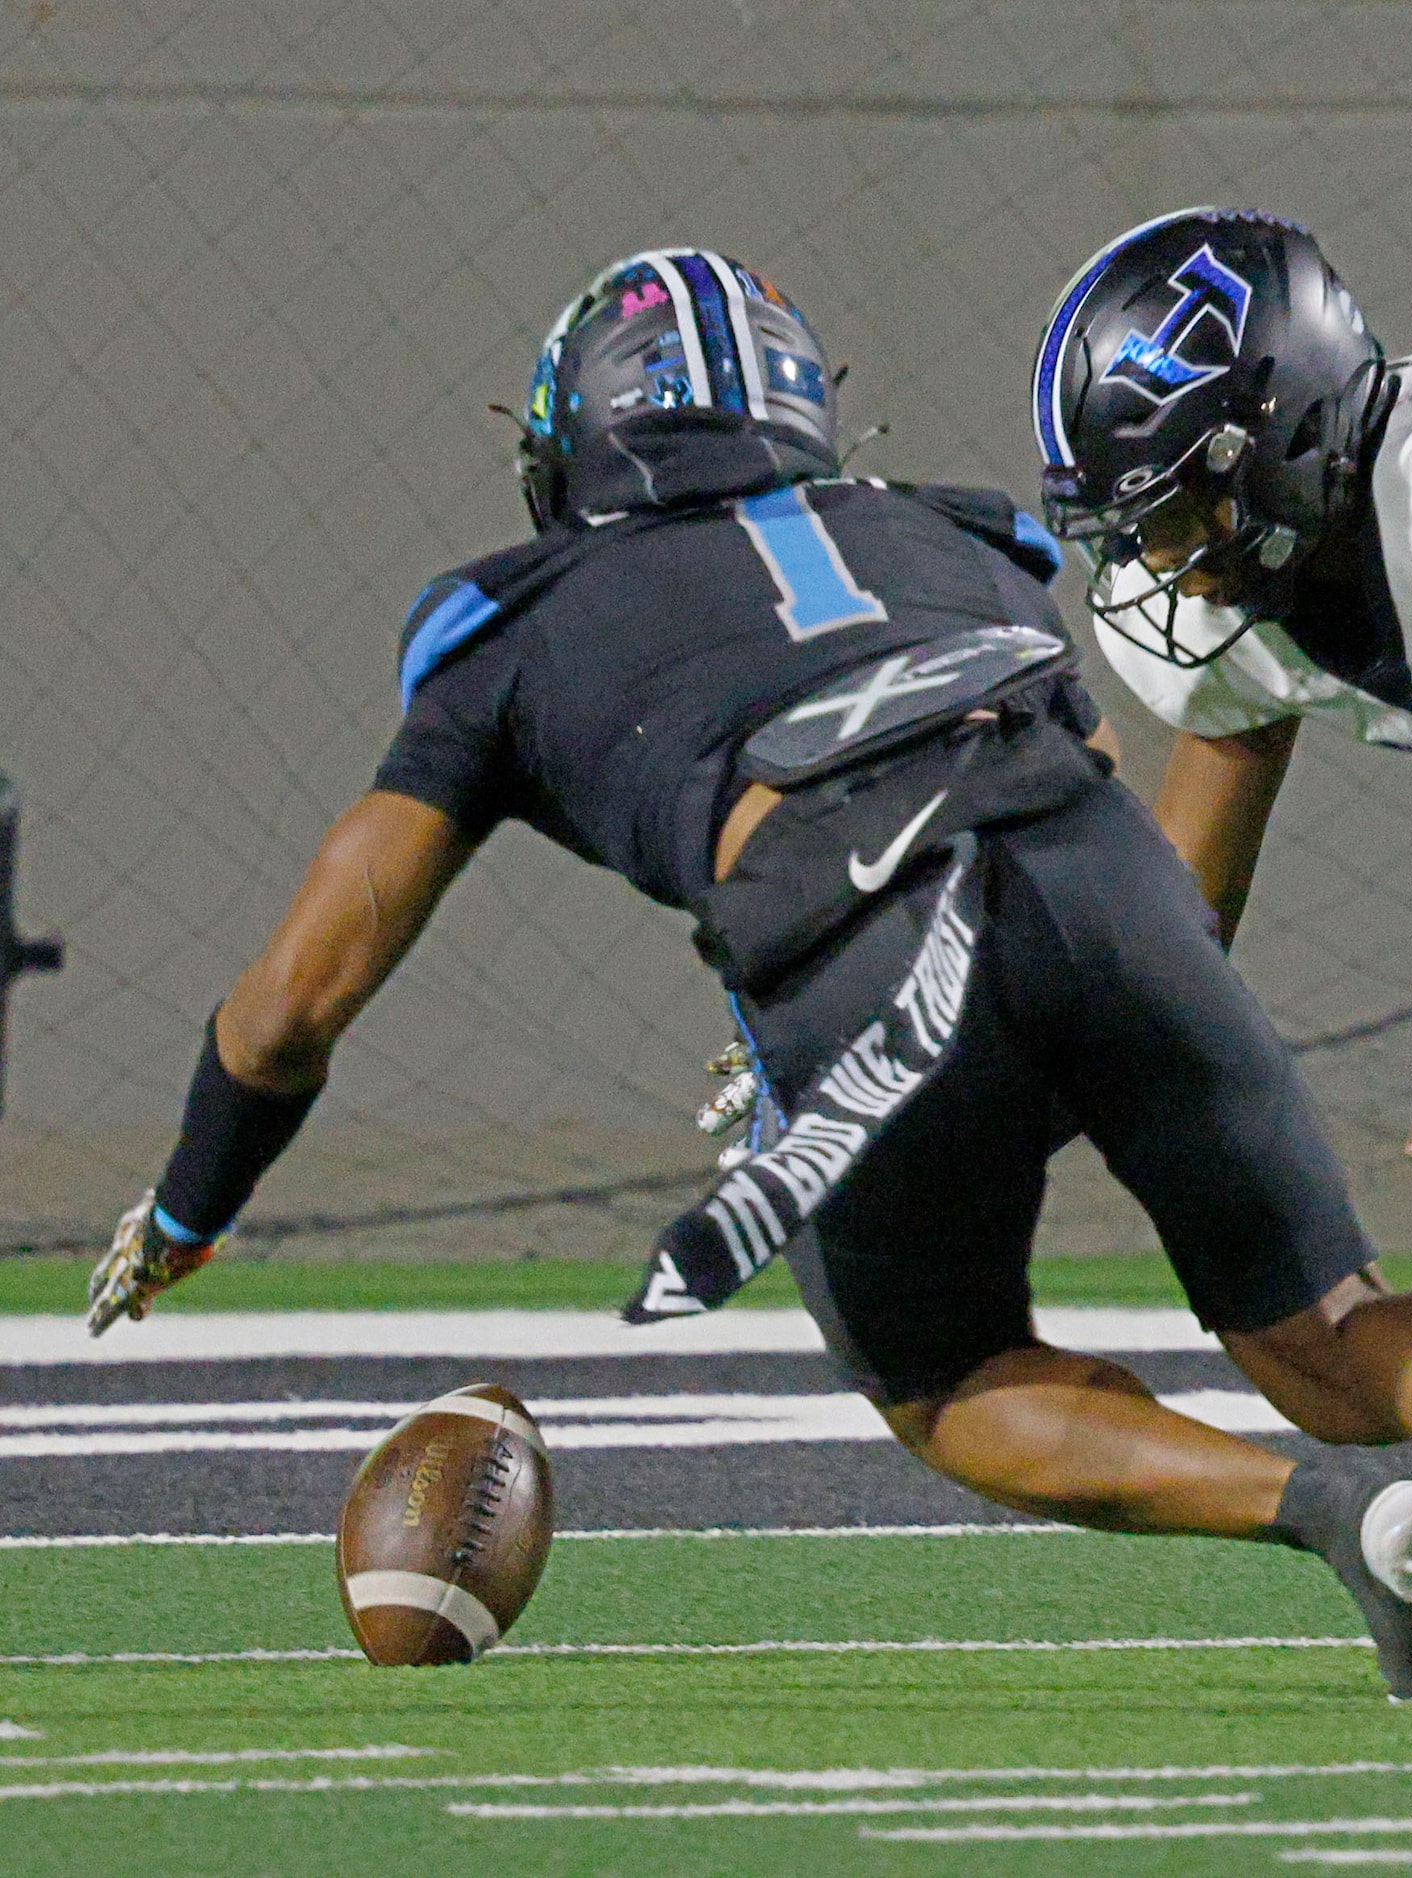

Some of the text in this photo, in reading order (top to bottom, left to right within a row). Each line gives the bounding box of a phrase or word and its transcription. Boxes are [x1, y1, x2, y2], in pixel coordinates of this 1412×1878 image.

[735, 486, 889, 643] 1
[705, 863, 975, 1282] IN GOD WE TRUST
